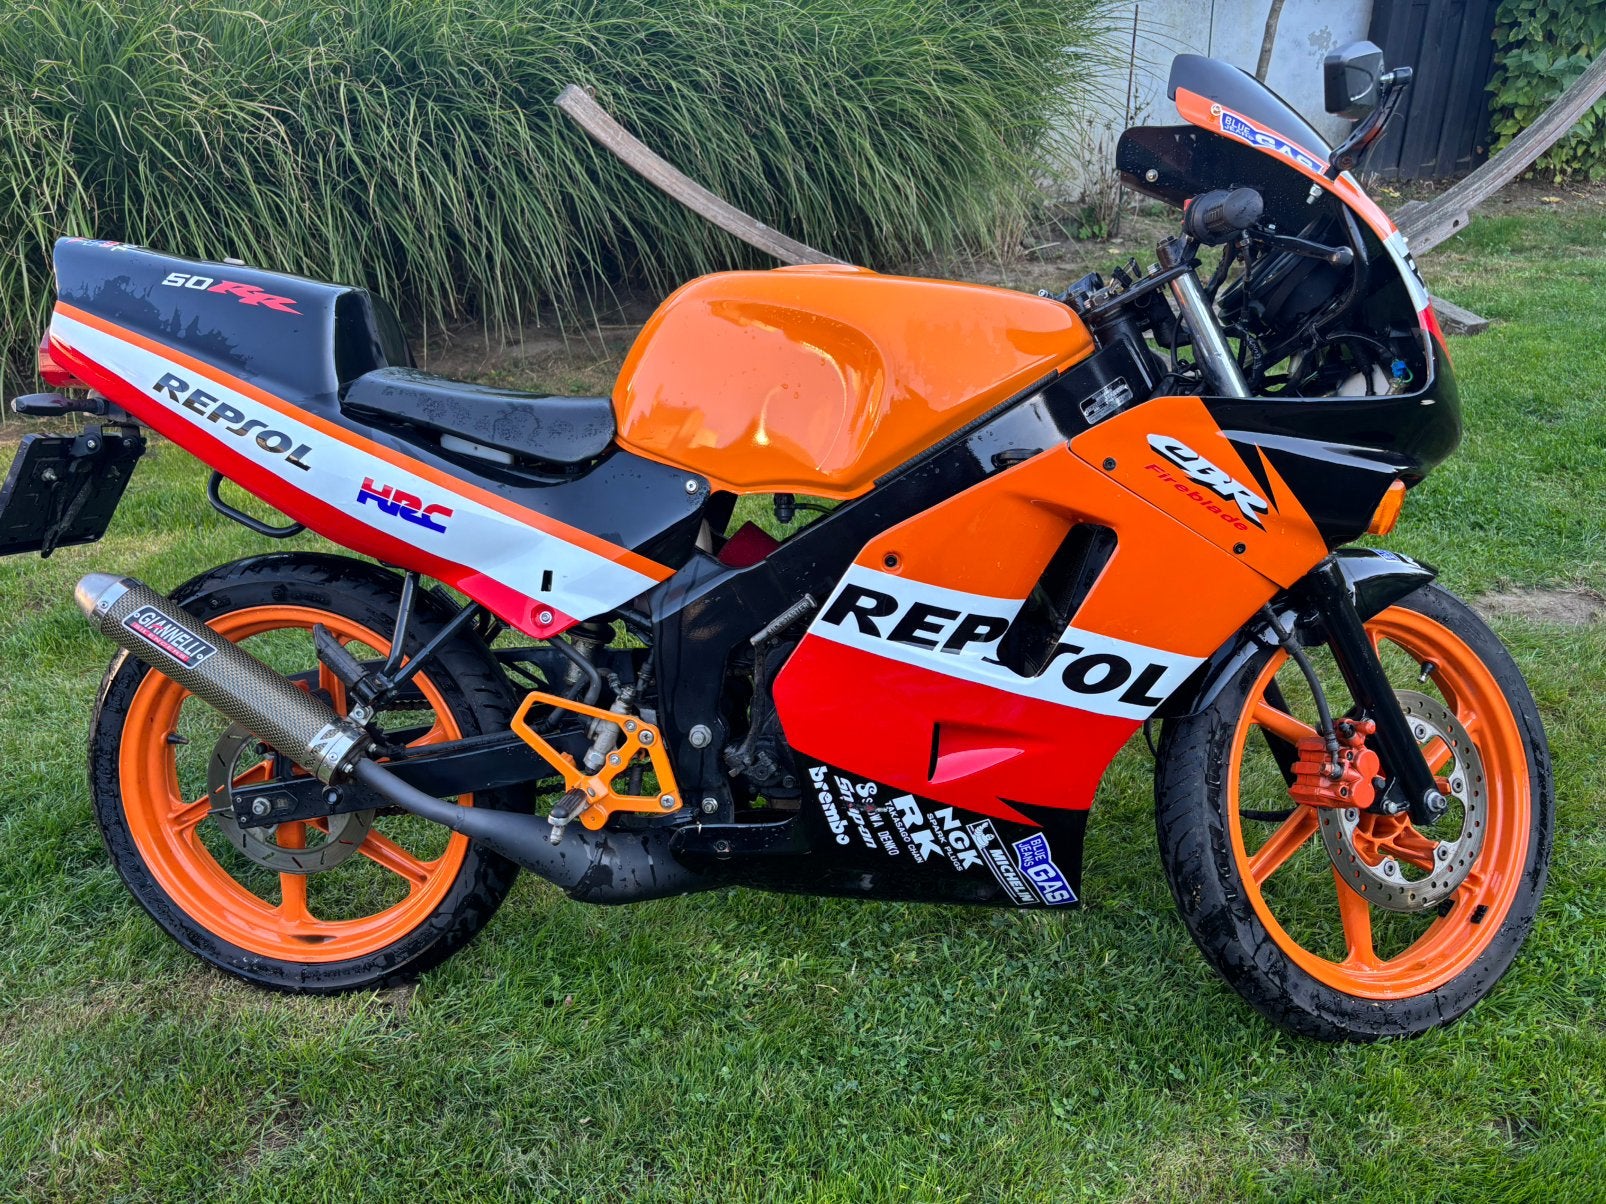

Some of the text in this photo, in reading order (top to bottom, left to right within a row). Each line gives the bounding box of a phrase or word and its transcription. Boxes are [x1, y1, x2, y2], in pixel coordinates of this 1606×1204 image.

[1225, 116, 1250, 134] BLUE
[152, 372, 313, 472] REPSOL
[356, 476, 455, 534] HRC
[1144, 463, 1249, 532] Fireblade
[1146, 433, 1269, 533] CBR
[138, 612, 207, 658] GIANNELLI
[820, 583, 1169, 707] REPOL
[808, 765, 850, 845] brembo
[833, 775, 878, 849] Snp-on
[884, 800, 912, 843] TAKASAGO
[892, 794, 946, 862] RK
[877, 830, 900, 856] DENKO
[926, 812, 964, 872] SPARK PLUGS
[934, 806, 984, 870] NGK
[1018, 843, 1035, 868] JEANS
[1030, 837, 1047, 862] BLUE
[988, 848, 1036, 902] MICHELIN
[1026, 863, 1071, 903] GAS
